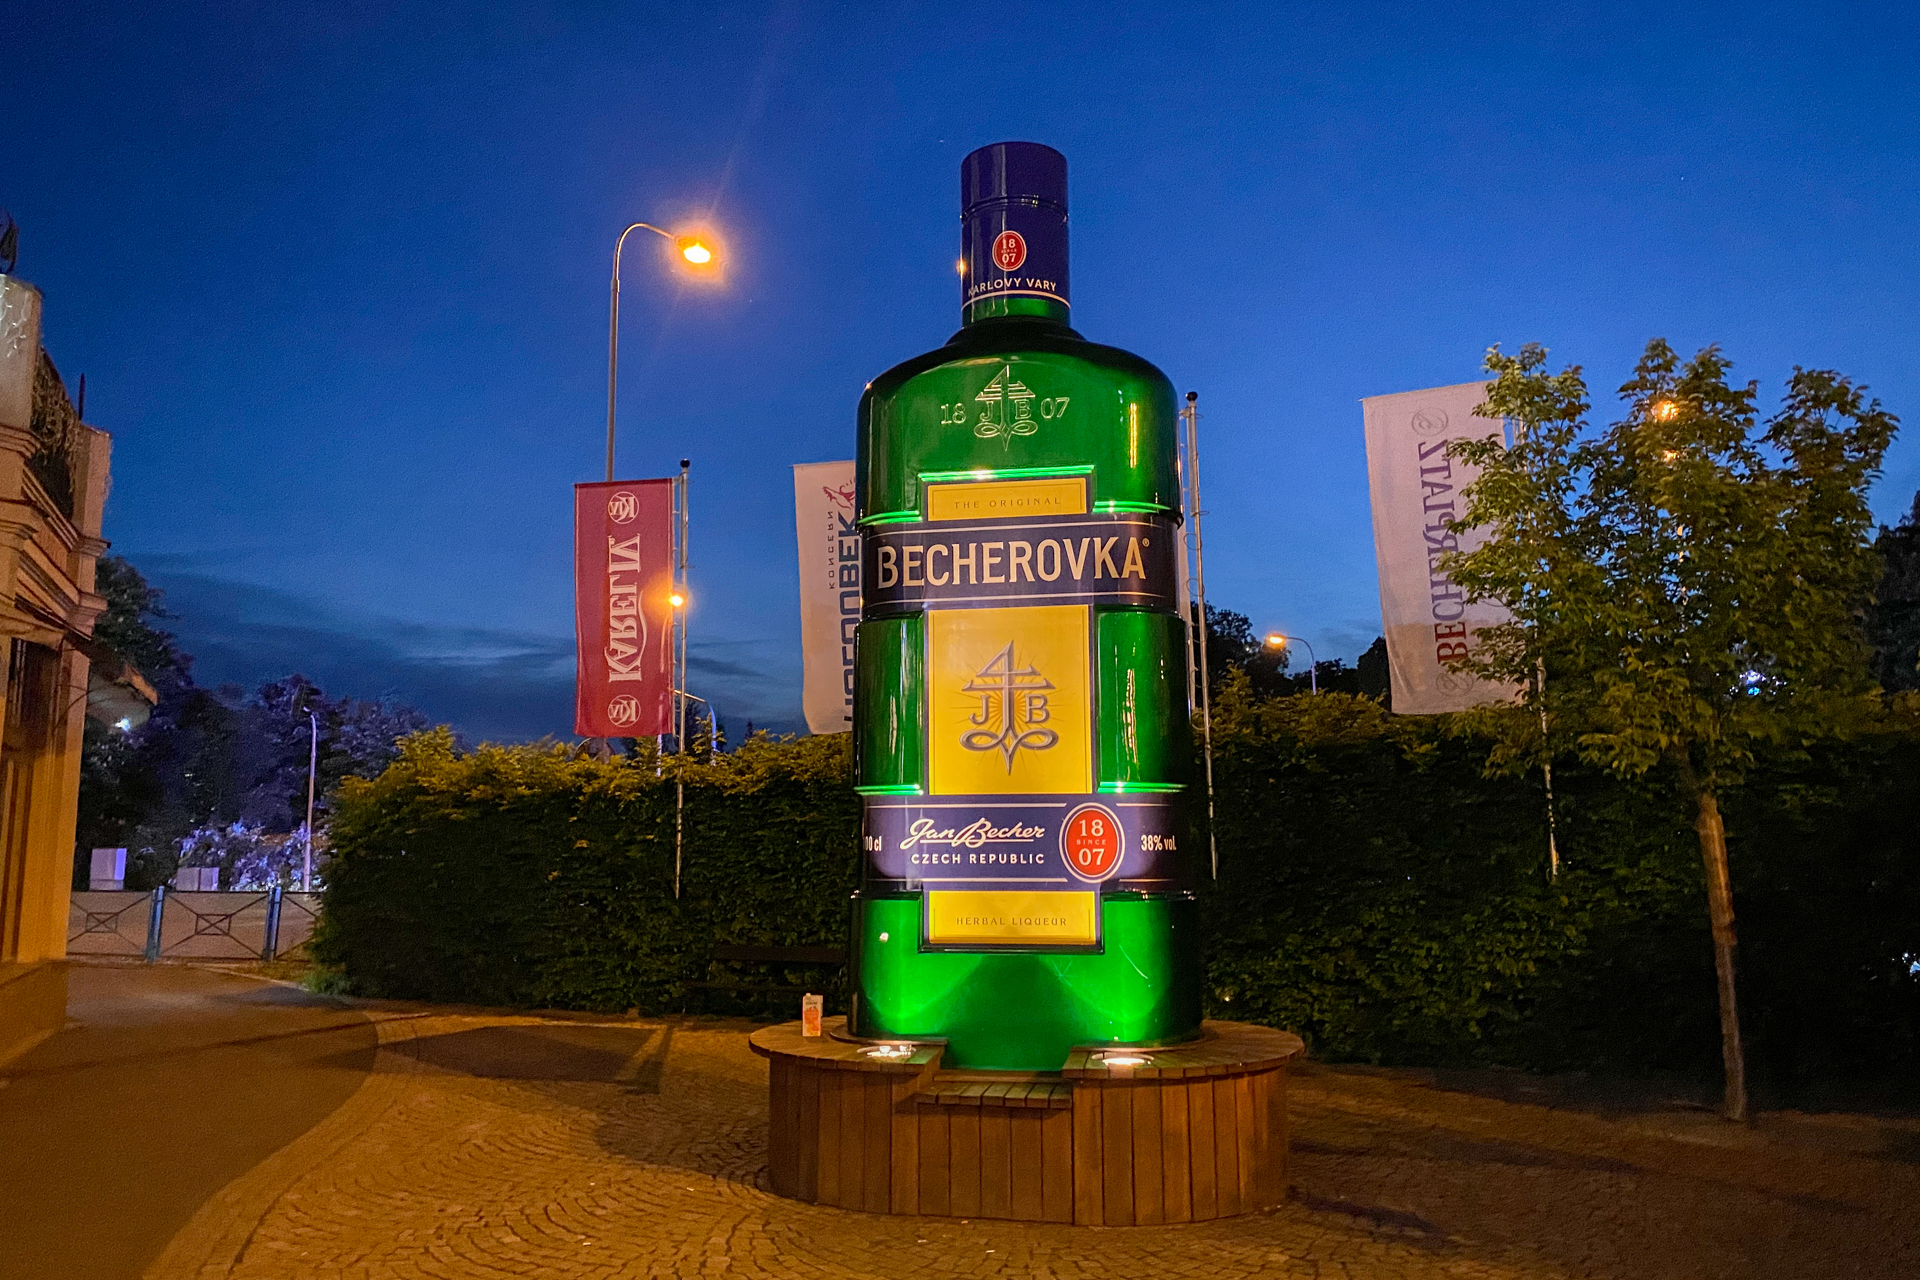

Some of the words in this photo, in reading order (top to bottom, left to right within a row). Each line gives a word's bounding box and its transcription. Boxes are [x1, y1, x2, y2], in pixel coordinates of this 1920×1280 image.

[1001, 238, 1016, 249] 18
[1001, 253, 1017, 263] 07
[967, 277, 1022, 297] KARLOVY
[1026, 278, 1057, 292] VARY
[940, 402, 966, 424] 18
[1040, 397, 1070, 419] 07
[954, 500, 980, 509] THE
[989, 497, 1061, 508] ORIGINAL
[899, 818, 956, 850] Jan
[951, 817, 1046, 848] Becher
[1079, 819, 1104, 837] 18
[1140, 834, 1163, 851] 38%
[911, 853, 961, 865] CZECH
[969, 853, 1045, 865] REPUBLIC
[1078, 848, 1105, 866] 07
[956, 916, 1007, 926] HERBAL
[1012, 916, 1067, 926] LIQUEUR
